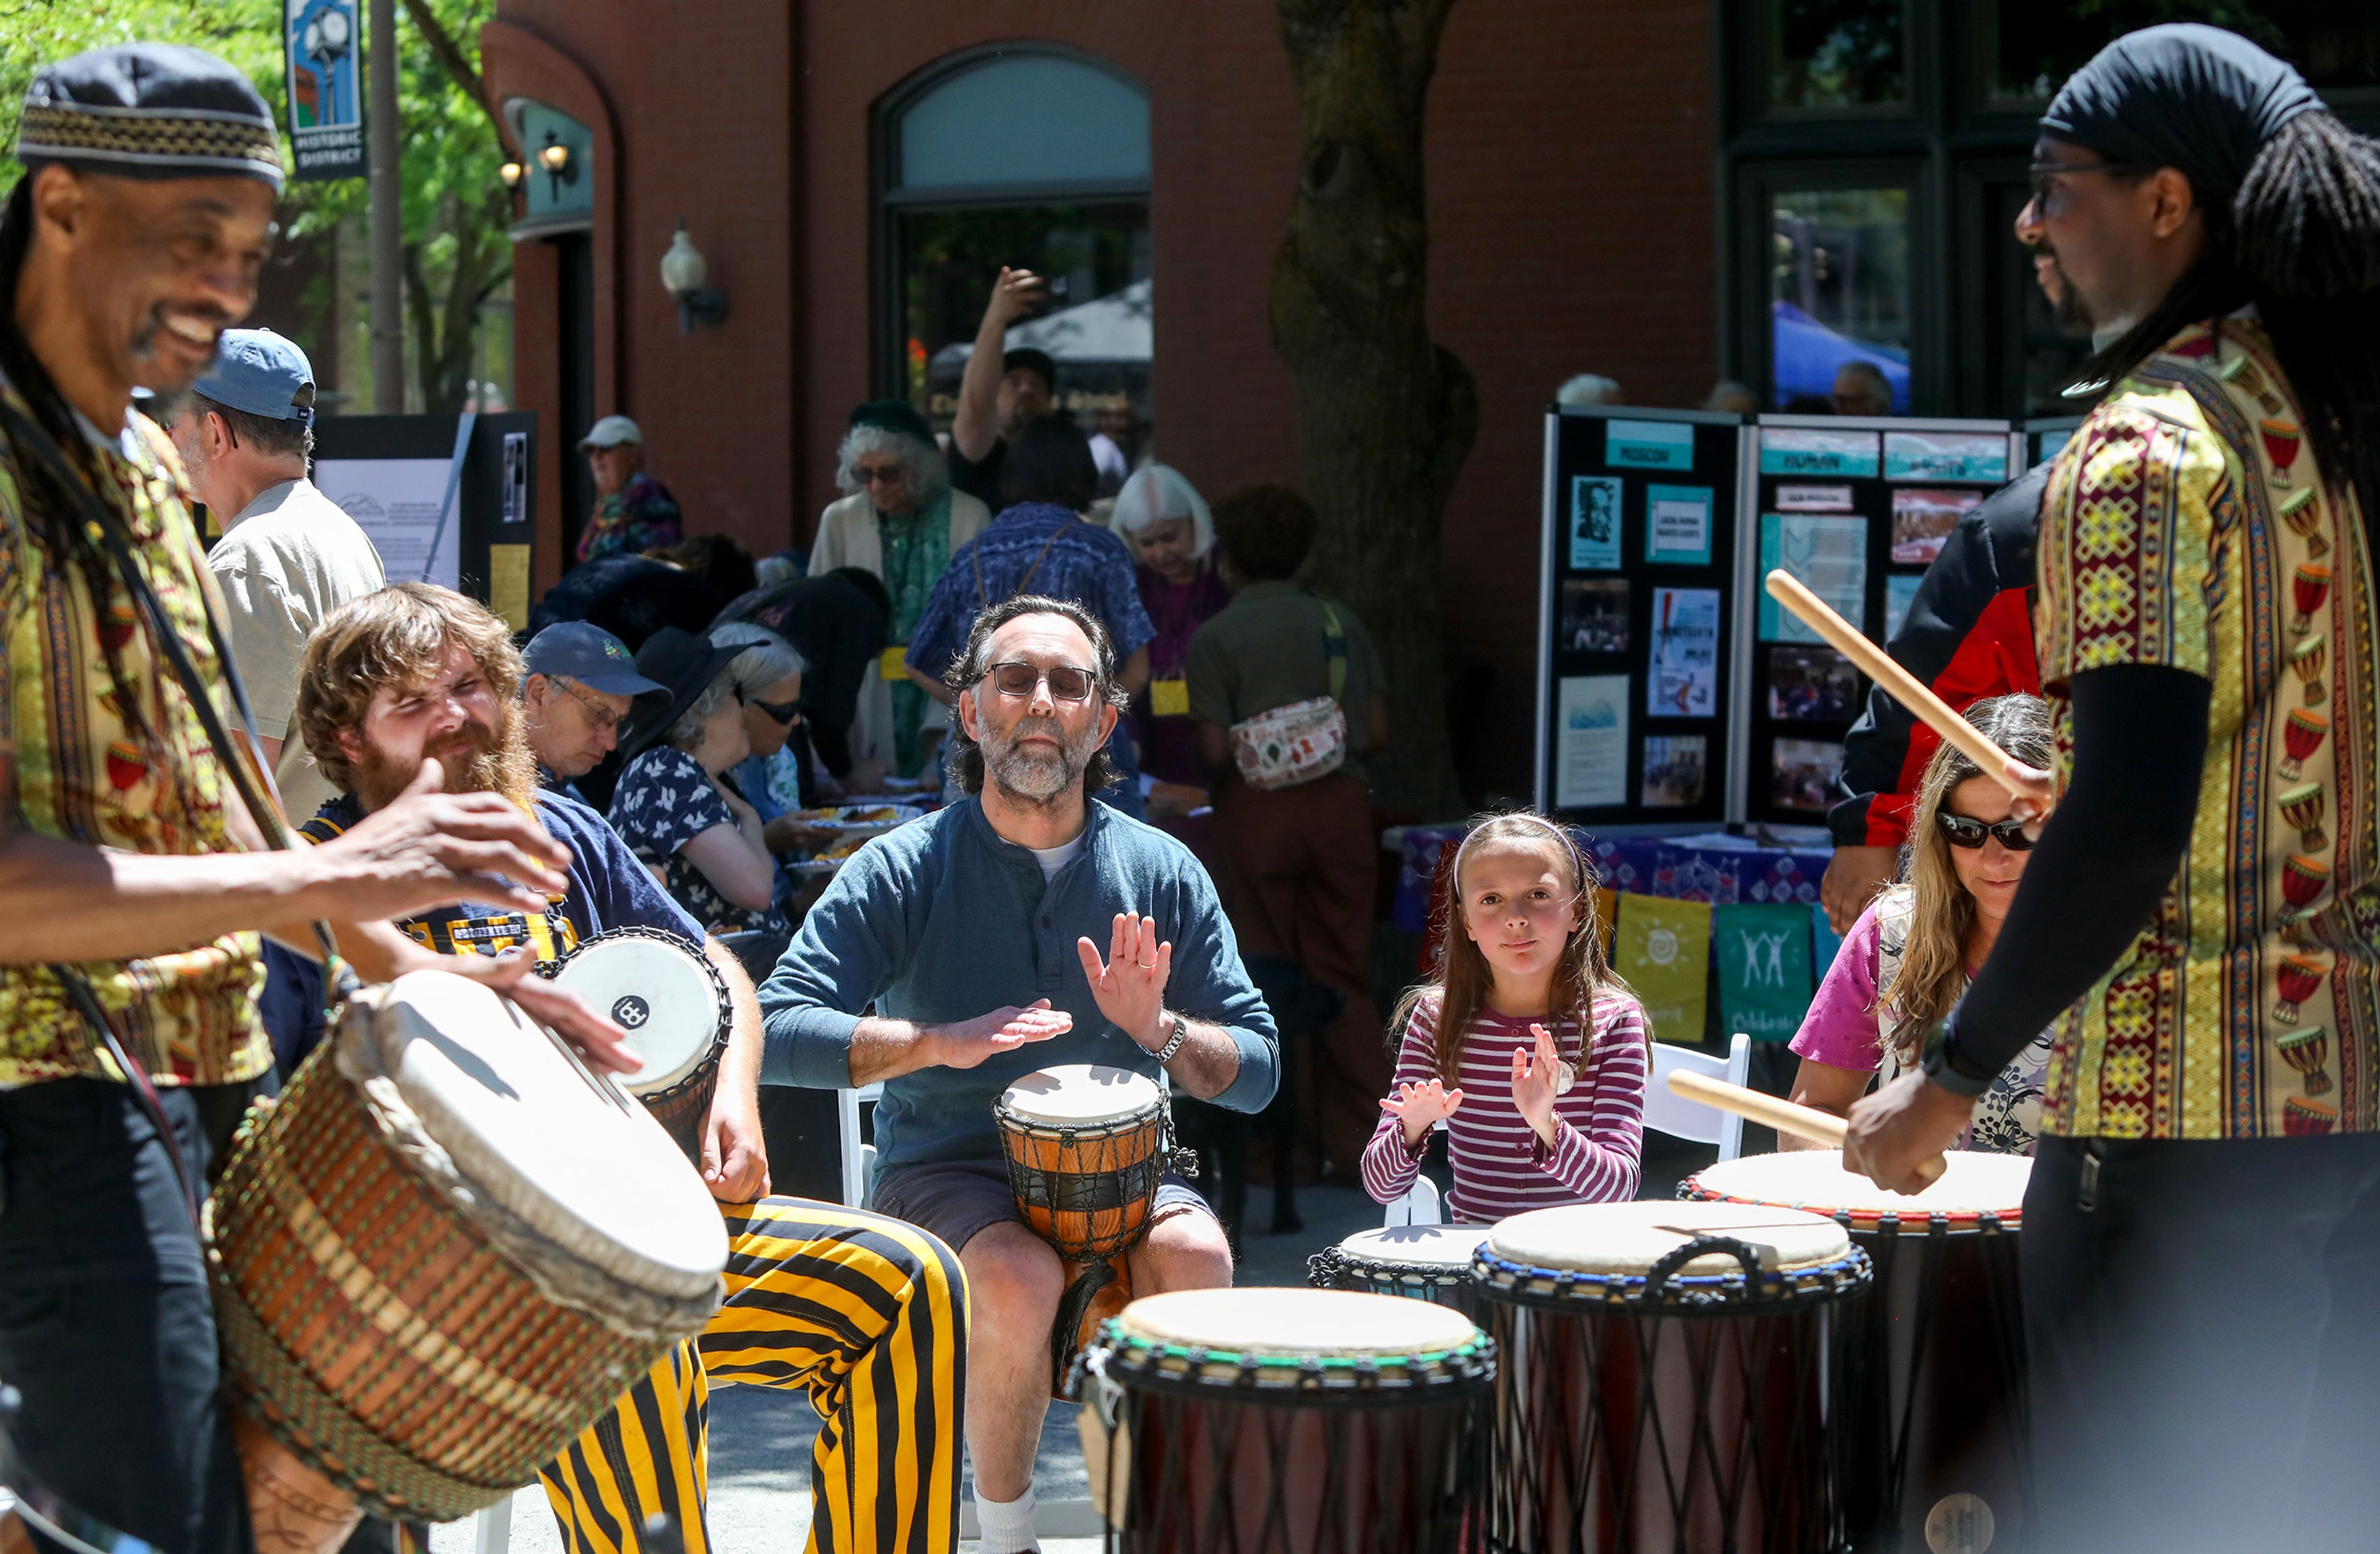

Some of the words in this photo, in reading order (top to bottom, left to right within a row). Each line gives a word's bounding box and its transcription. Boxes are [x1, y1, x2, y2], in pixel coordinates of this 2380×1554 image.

[296, 130, 361, 149] HISTORIC
[299, 147, 361, 168] DISTRICT
[1620, 447, 1670, 463] MOSCOW
[1784, 454, 1840, 470] HUMAN
